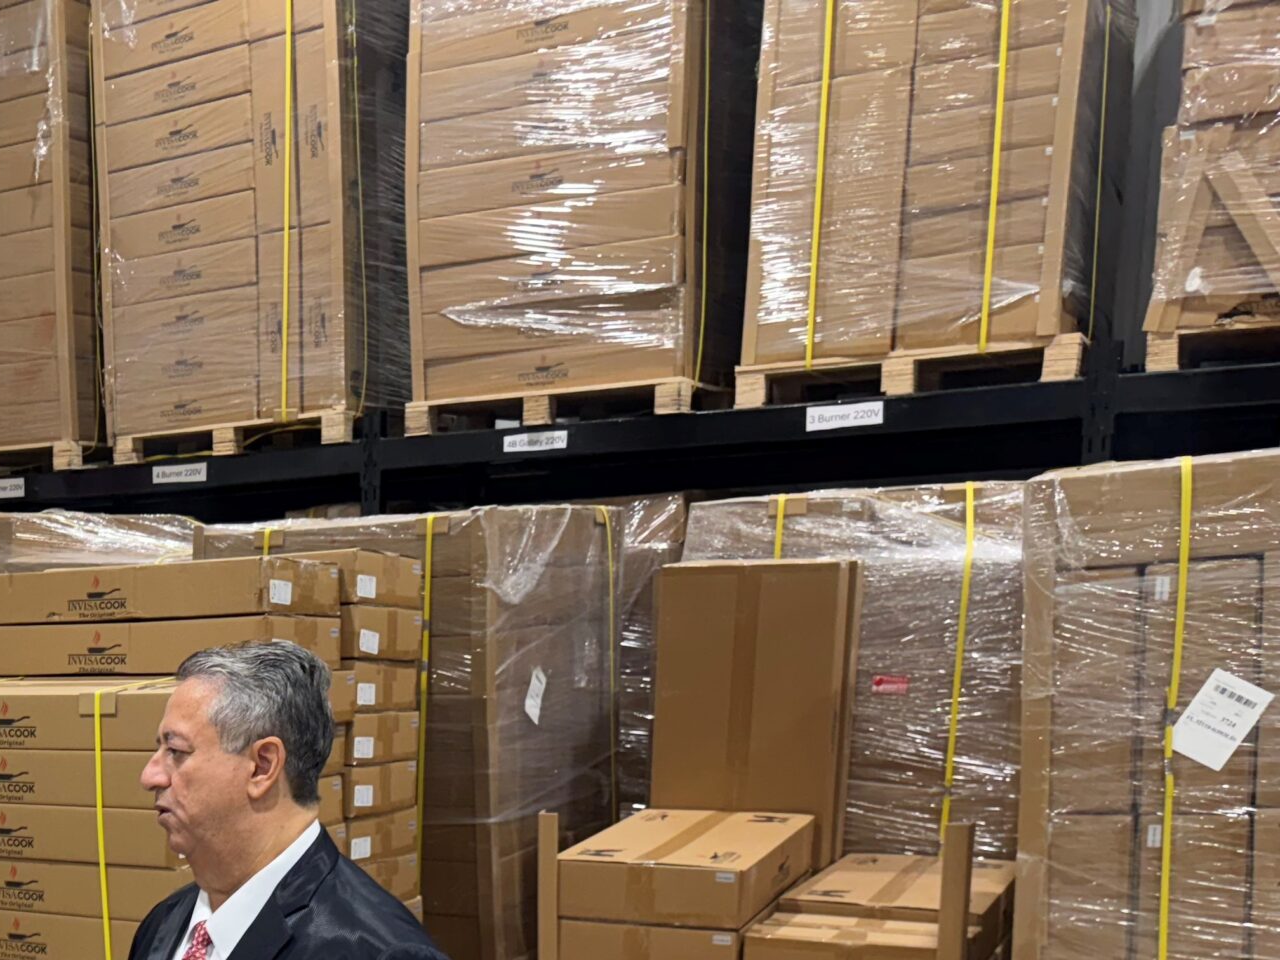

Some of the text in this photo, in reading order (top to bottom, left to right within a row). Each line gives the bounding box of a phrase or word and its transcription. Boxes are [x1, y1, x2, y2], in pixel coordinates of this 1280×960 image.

[809, 408, 881, 425] 3 Burner 220V
[155, 467, 203, 479] 4 Burner 220V
[67, 599, 127, 612] INVISACOOK
[67, 655, 127, 666] INVISACOOK
